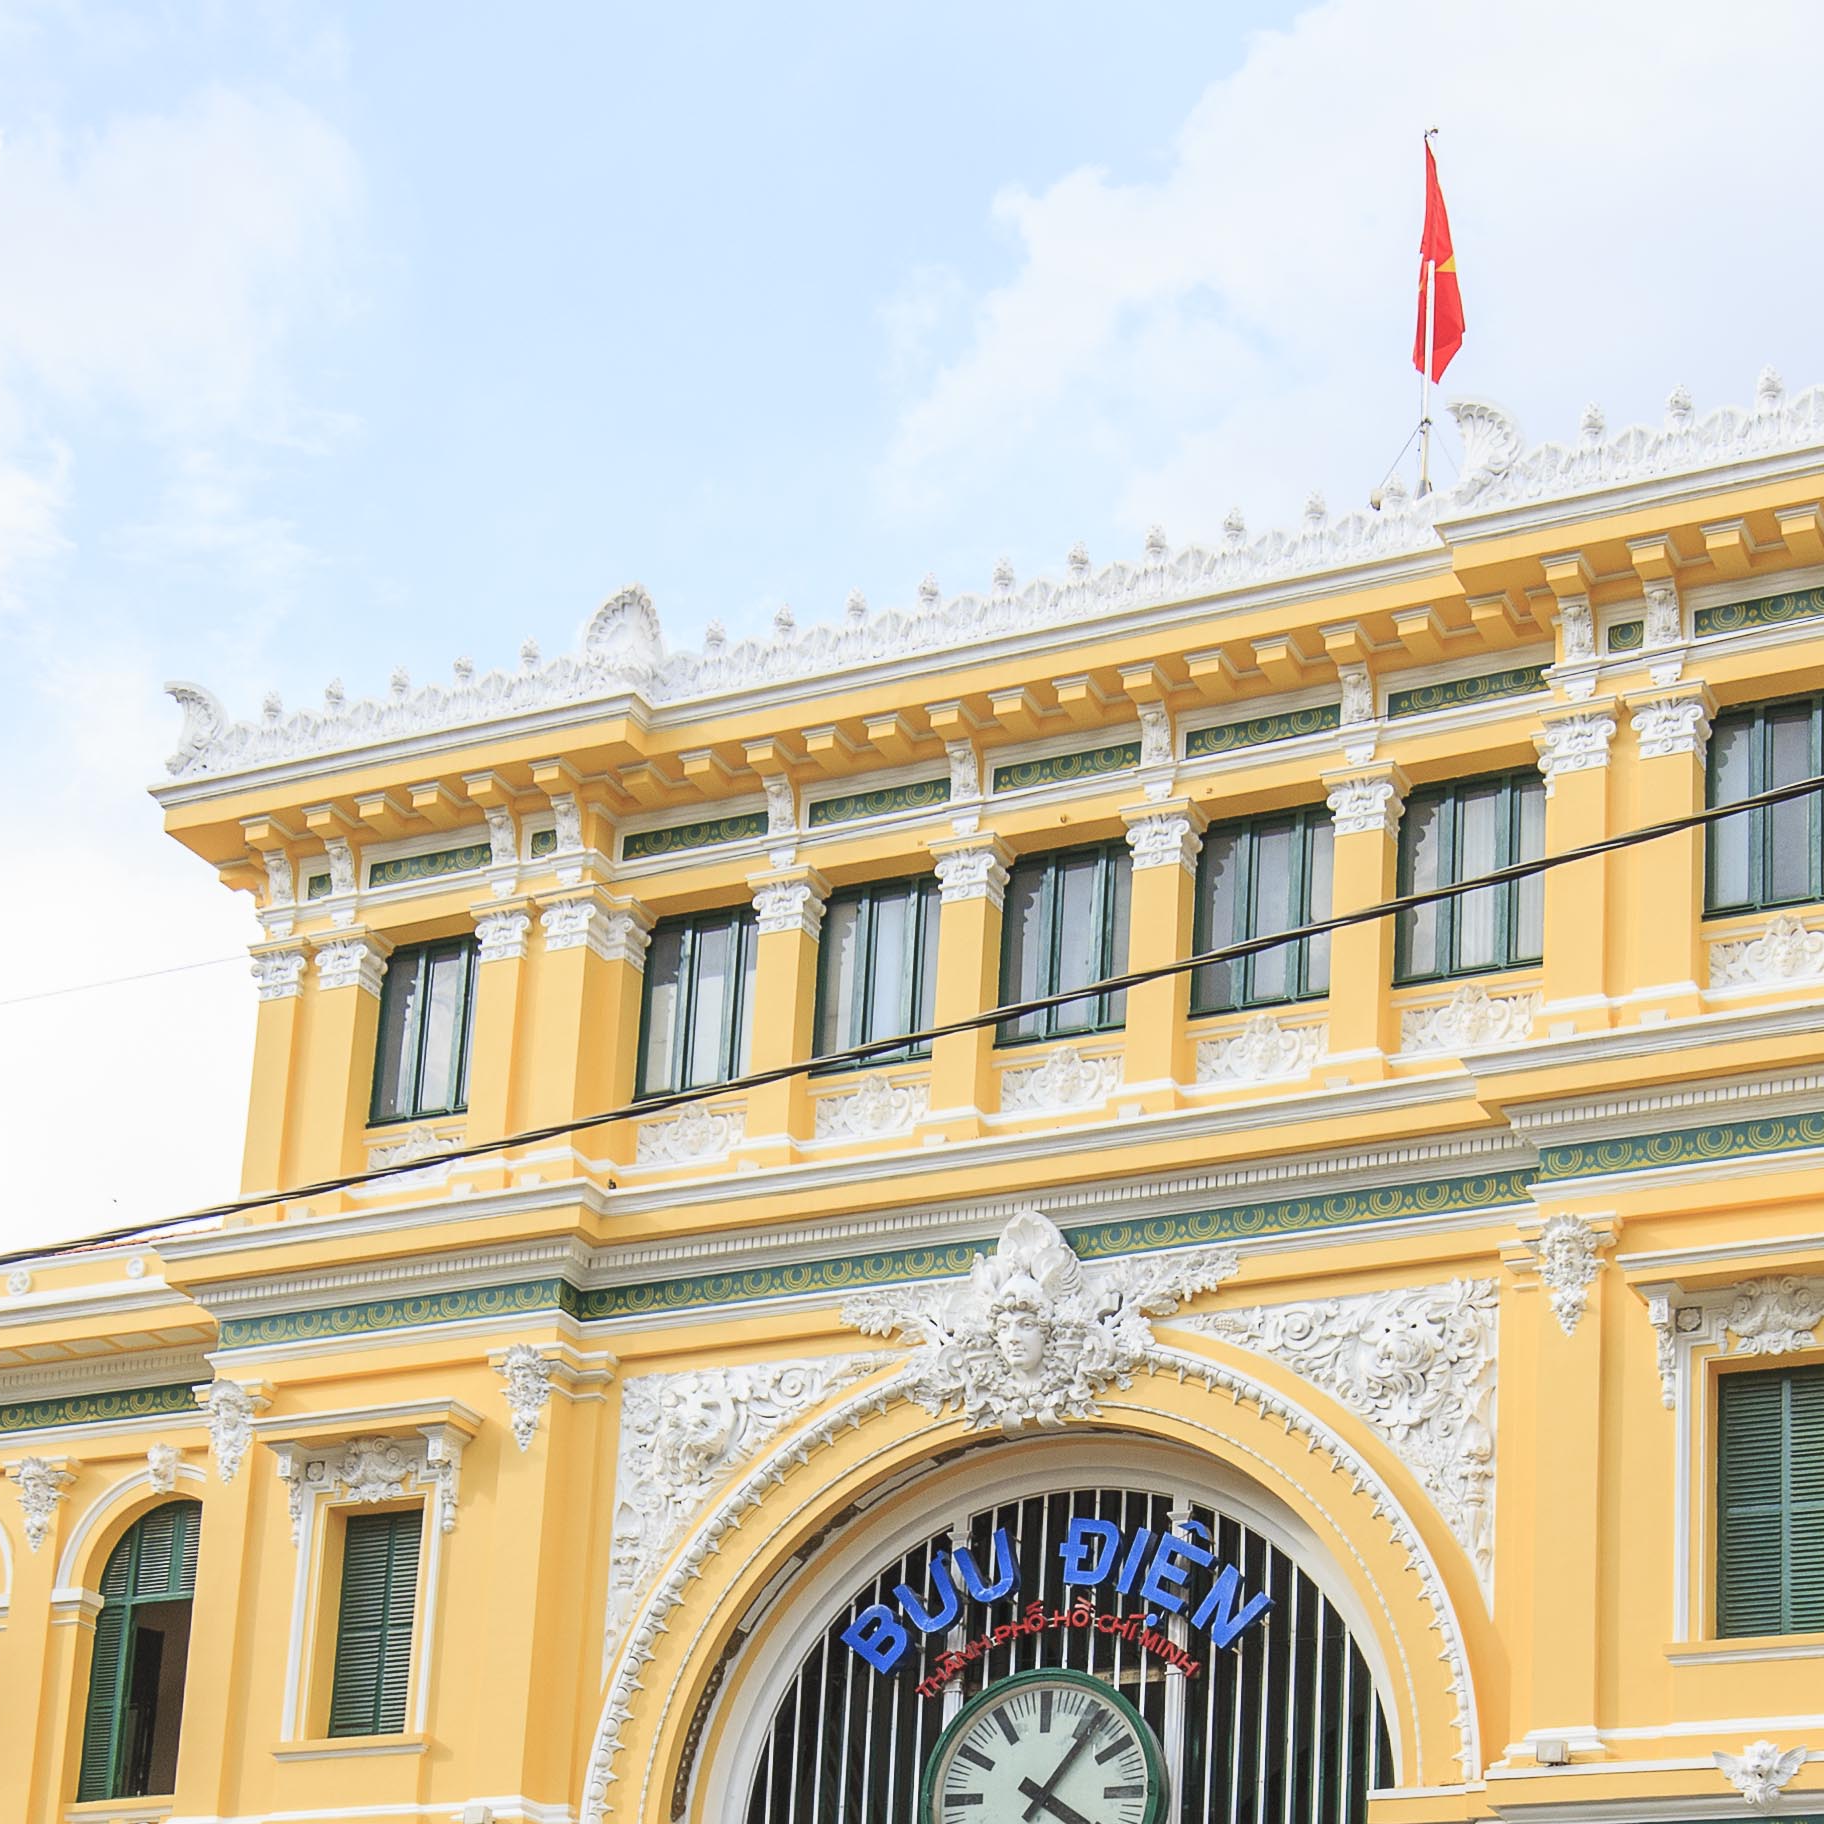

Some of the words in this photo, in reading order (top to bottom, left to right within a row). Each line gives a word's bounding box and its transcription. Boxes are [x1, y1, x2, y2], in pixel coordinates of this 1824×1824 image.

[840, 1526, 1023, 1676] BƯU
[1059, 1517, 1275, 1650] ĐIỆN
[1053, 1596, 1093, 1629] HỒ
[1137, 1630, 1201, 1679] MINH
